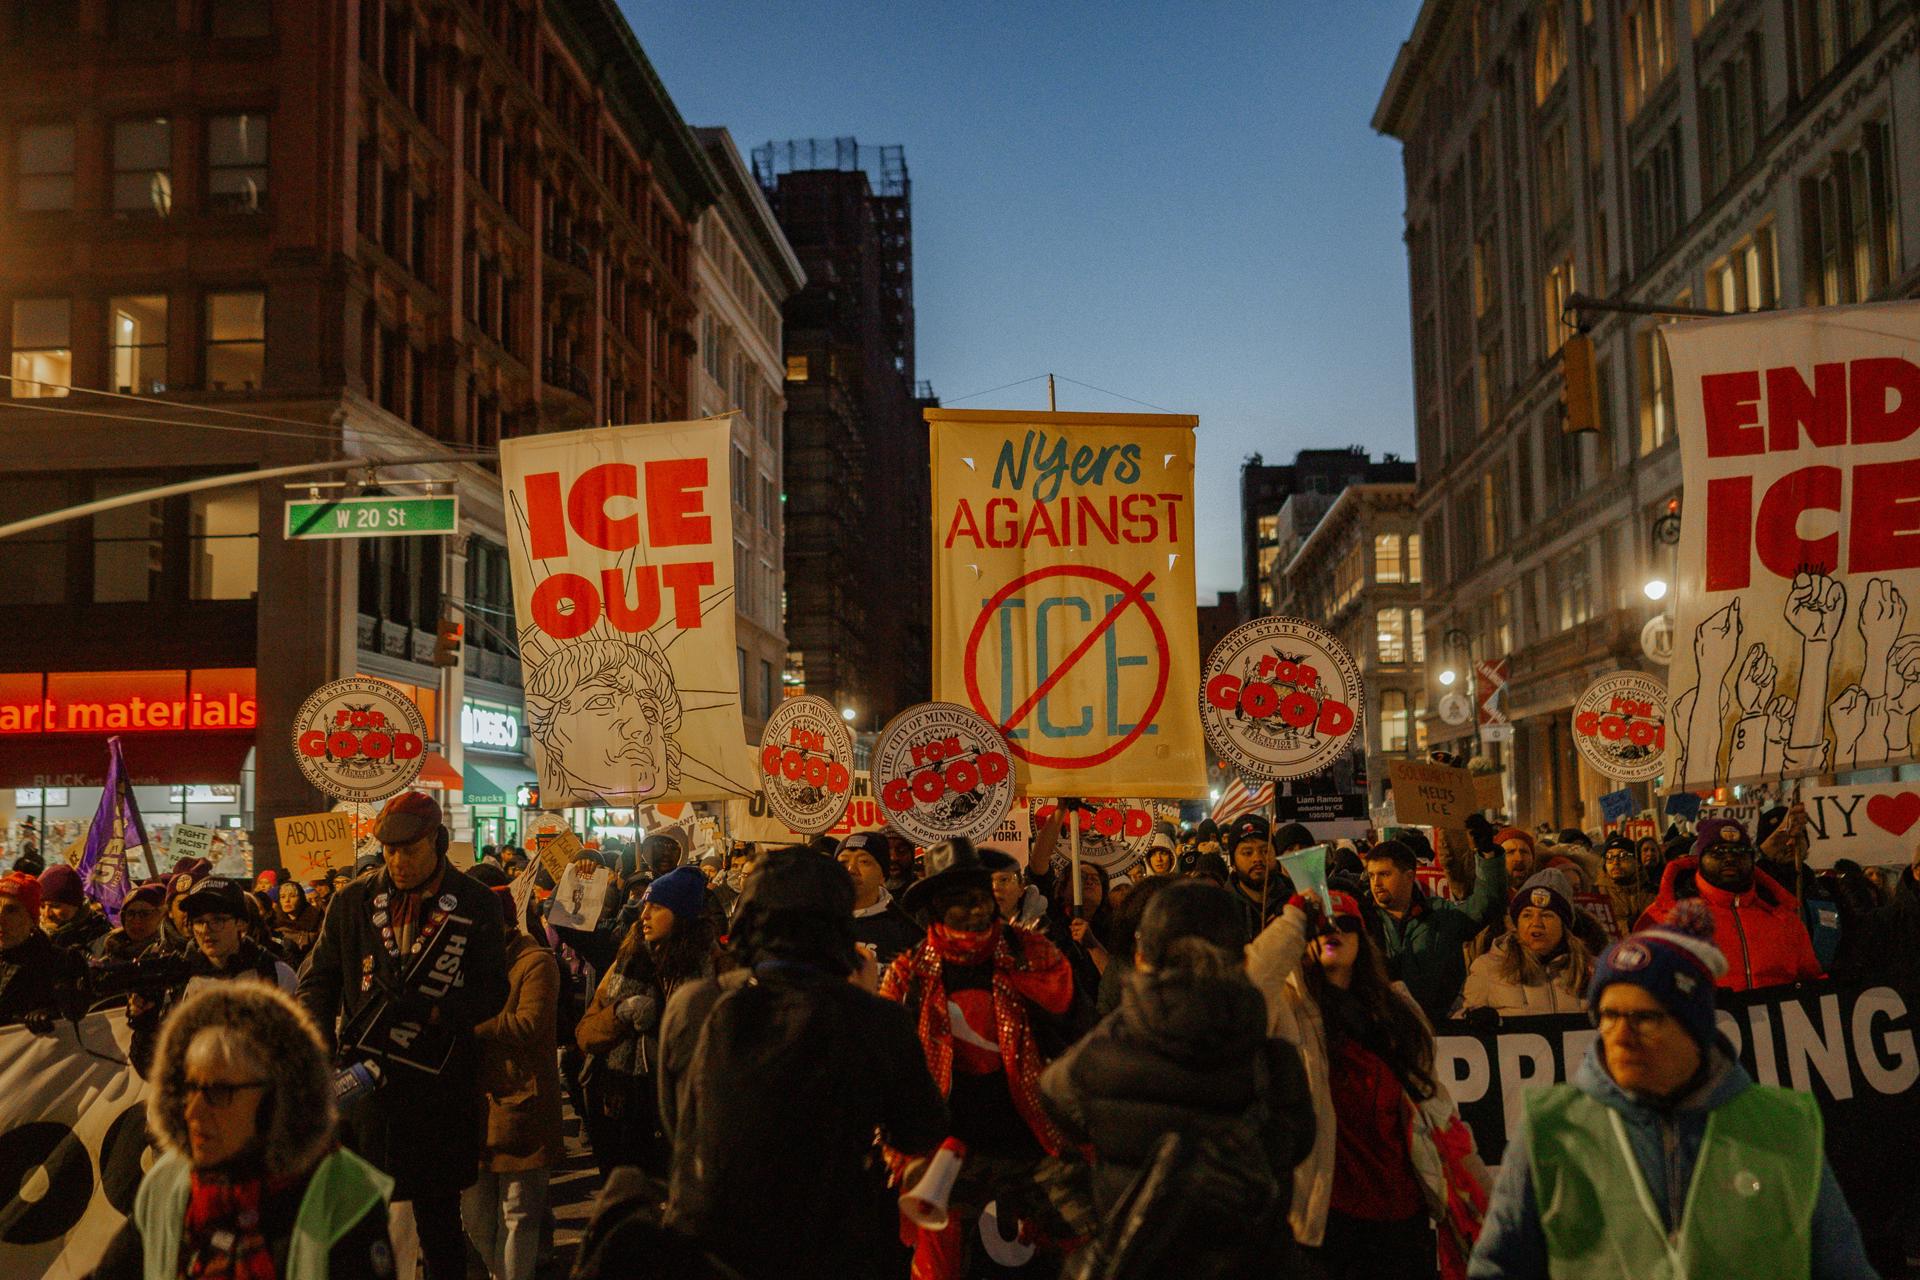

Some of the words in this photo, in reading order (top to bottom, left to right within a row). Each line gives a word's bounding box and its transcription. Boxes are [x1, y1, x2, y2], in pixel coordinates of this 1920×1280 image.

[1701, 357, 1920, 459] END
[336, 509, 351, 529] W
[356, 508, 380, 528] 20
[387, 507, 406, 527] St
[524, 457, 712, 560] ICE
[944, 493, 1183, 549] AGAINST
[1706, 458, 1920, 592] ICE
[531, 561, 715, 639] OUT
[981, 592, 1158, 739] ICE
[1213, 655, 1226, 673] OF
[1227, 633, 1252, 653] THE
[1256, 624, 1299, 636] STATE
[1306, 631, 1323, 642] OF
[1324, 642, 1349, 666] NEW
[1343, 664, 1359, 701] YORK
[1258, 654, 1318, 690] FOR
[306, 698, 324, 717] THE
[326, 683, 361, 698] STATE
[367, 684, 381, 693] OF
[384, 689, 406, 709] NEW
[404, 704, 421, 731] YORK
[1206, 673, 1355, 737] GOOD
[1584, 691, 1599, 710] THE
[1599, 679, 1620, 696] CITY
[1620, 678, 1631, 687] OF
[1610, 697, 1653, 718] FOR
[0, 698, 56, 730] art
[67, 692, 256, 729] materials
[335, 709, 385, 728] FOR
[298, 730, 423, 760] GOOD
[767, 723, 781, 743] THE
[780, 708, 797, 722] CITY
[796, 704, 807, 714] OF
[808, 705, 848, 763] MINNEAPOLIS
[790, 726, 824, 753] FOR
[881, 751, 894, 777] THE
[889, 724, 912, 751] CITY
[909, 718, 923, 731] OF
[925, 711, 998, 750] MINNEAPOLIS
[911, 736, 966, 767] FOR
[34, 774, 86, 787] BLICK
[762, 744, 850, 794] GOOD
[882, 751, 1009, 812] GOOD
[468, 794, 504, 803] Snacks
[770, 792, 797, 822] APPROVED
[796, 815, 812, 826] JUNE
[1418, 785, 1455, 804] MELTS
[1426, 803, 1451, 816] ICE
[990, 800, 1004, 822] 1878
[1699, 808, 1719, 820] CE
[1723, 806, 1757, 820] OUT
[1804, 795, 1865, 840] NY
[175, 837, 209, 850] RACIST
[177, 827, 208, 840] FIGHT
[286, 817, 347, 847] ABOLISH
[992, 831, 1022, 842] YORK!
[178, 848, 196, 857] AND
[308, 849, 334, 868] ICE
